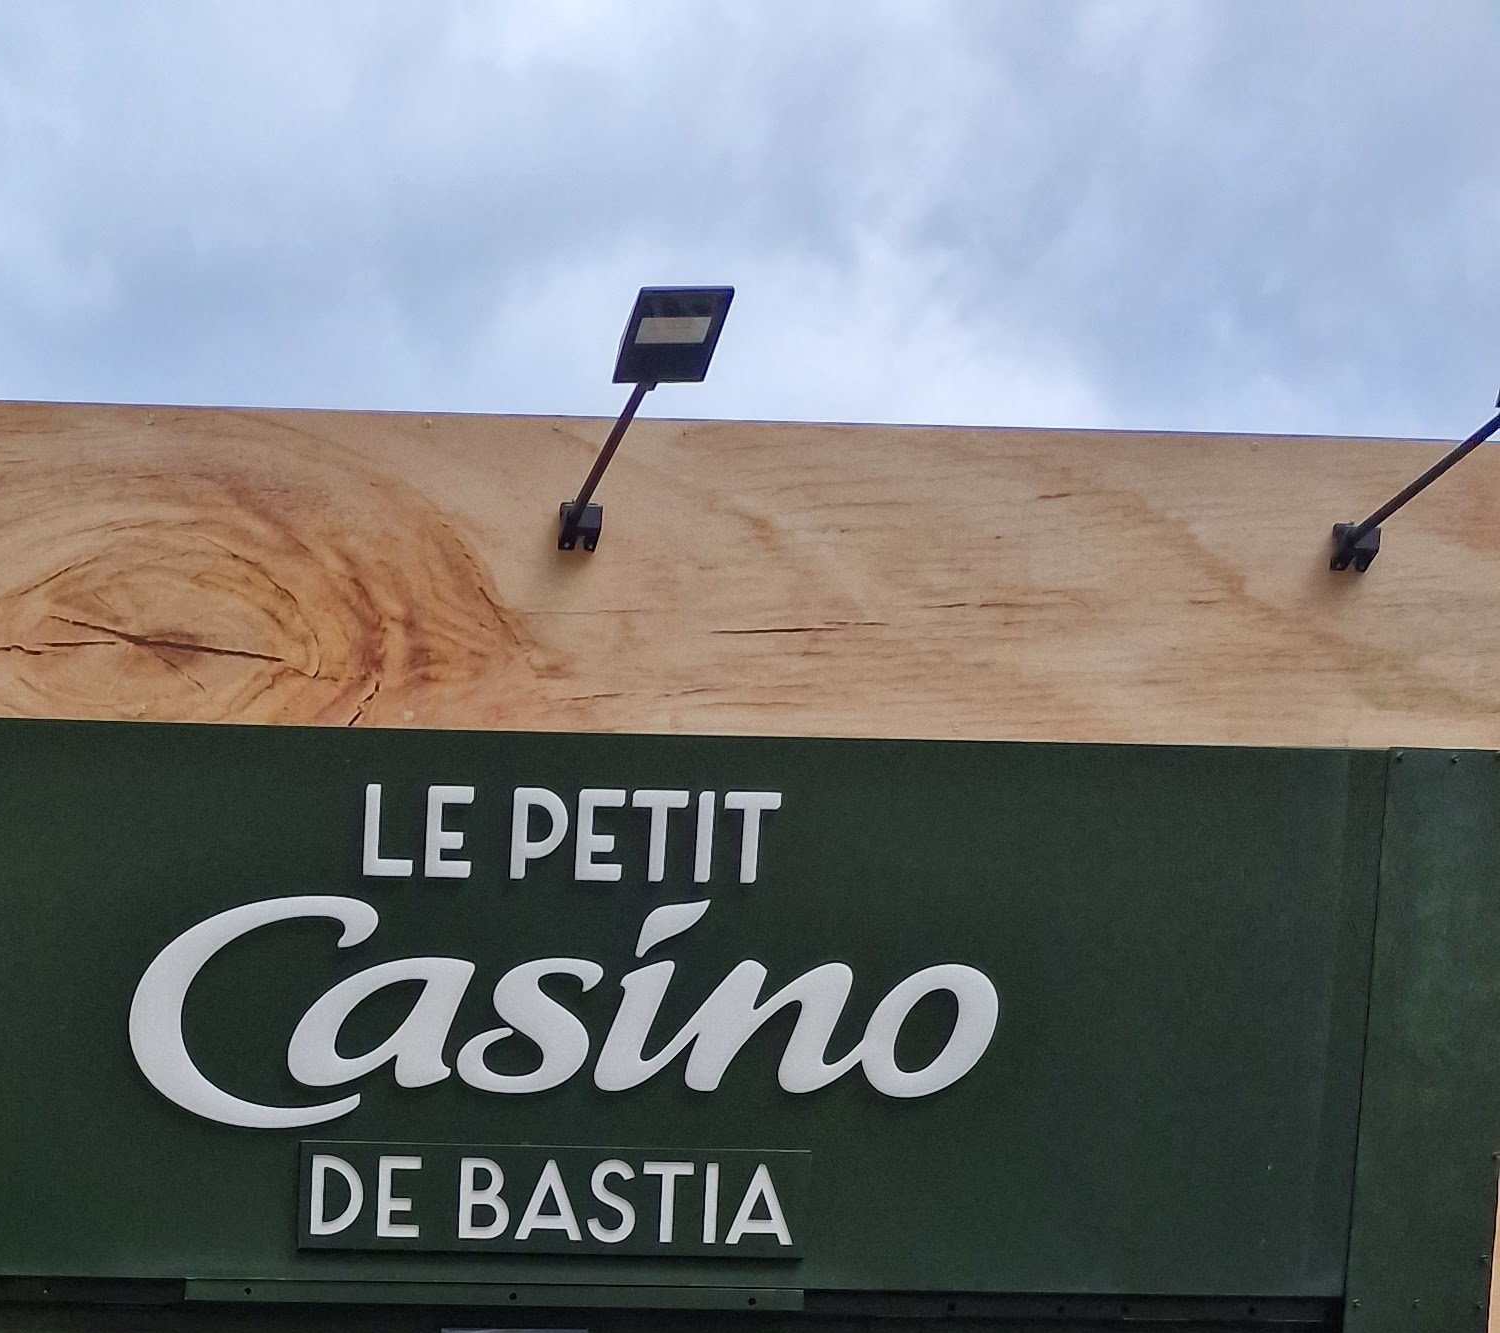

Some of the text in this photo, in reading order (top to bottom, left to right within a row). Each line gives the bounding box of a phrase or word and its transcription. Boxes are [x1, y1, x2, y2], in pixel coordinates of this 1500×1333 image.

[363, 782, 783, 884] LE PETIT
[128, 894, 1001, 1130] Casino
[309, 1154, 793, 1246] DE BASTIA
